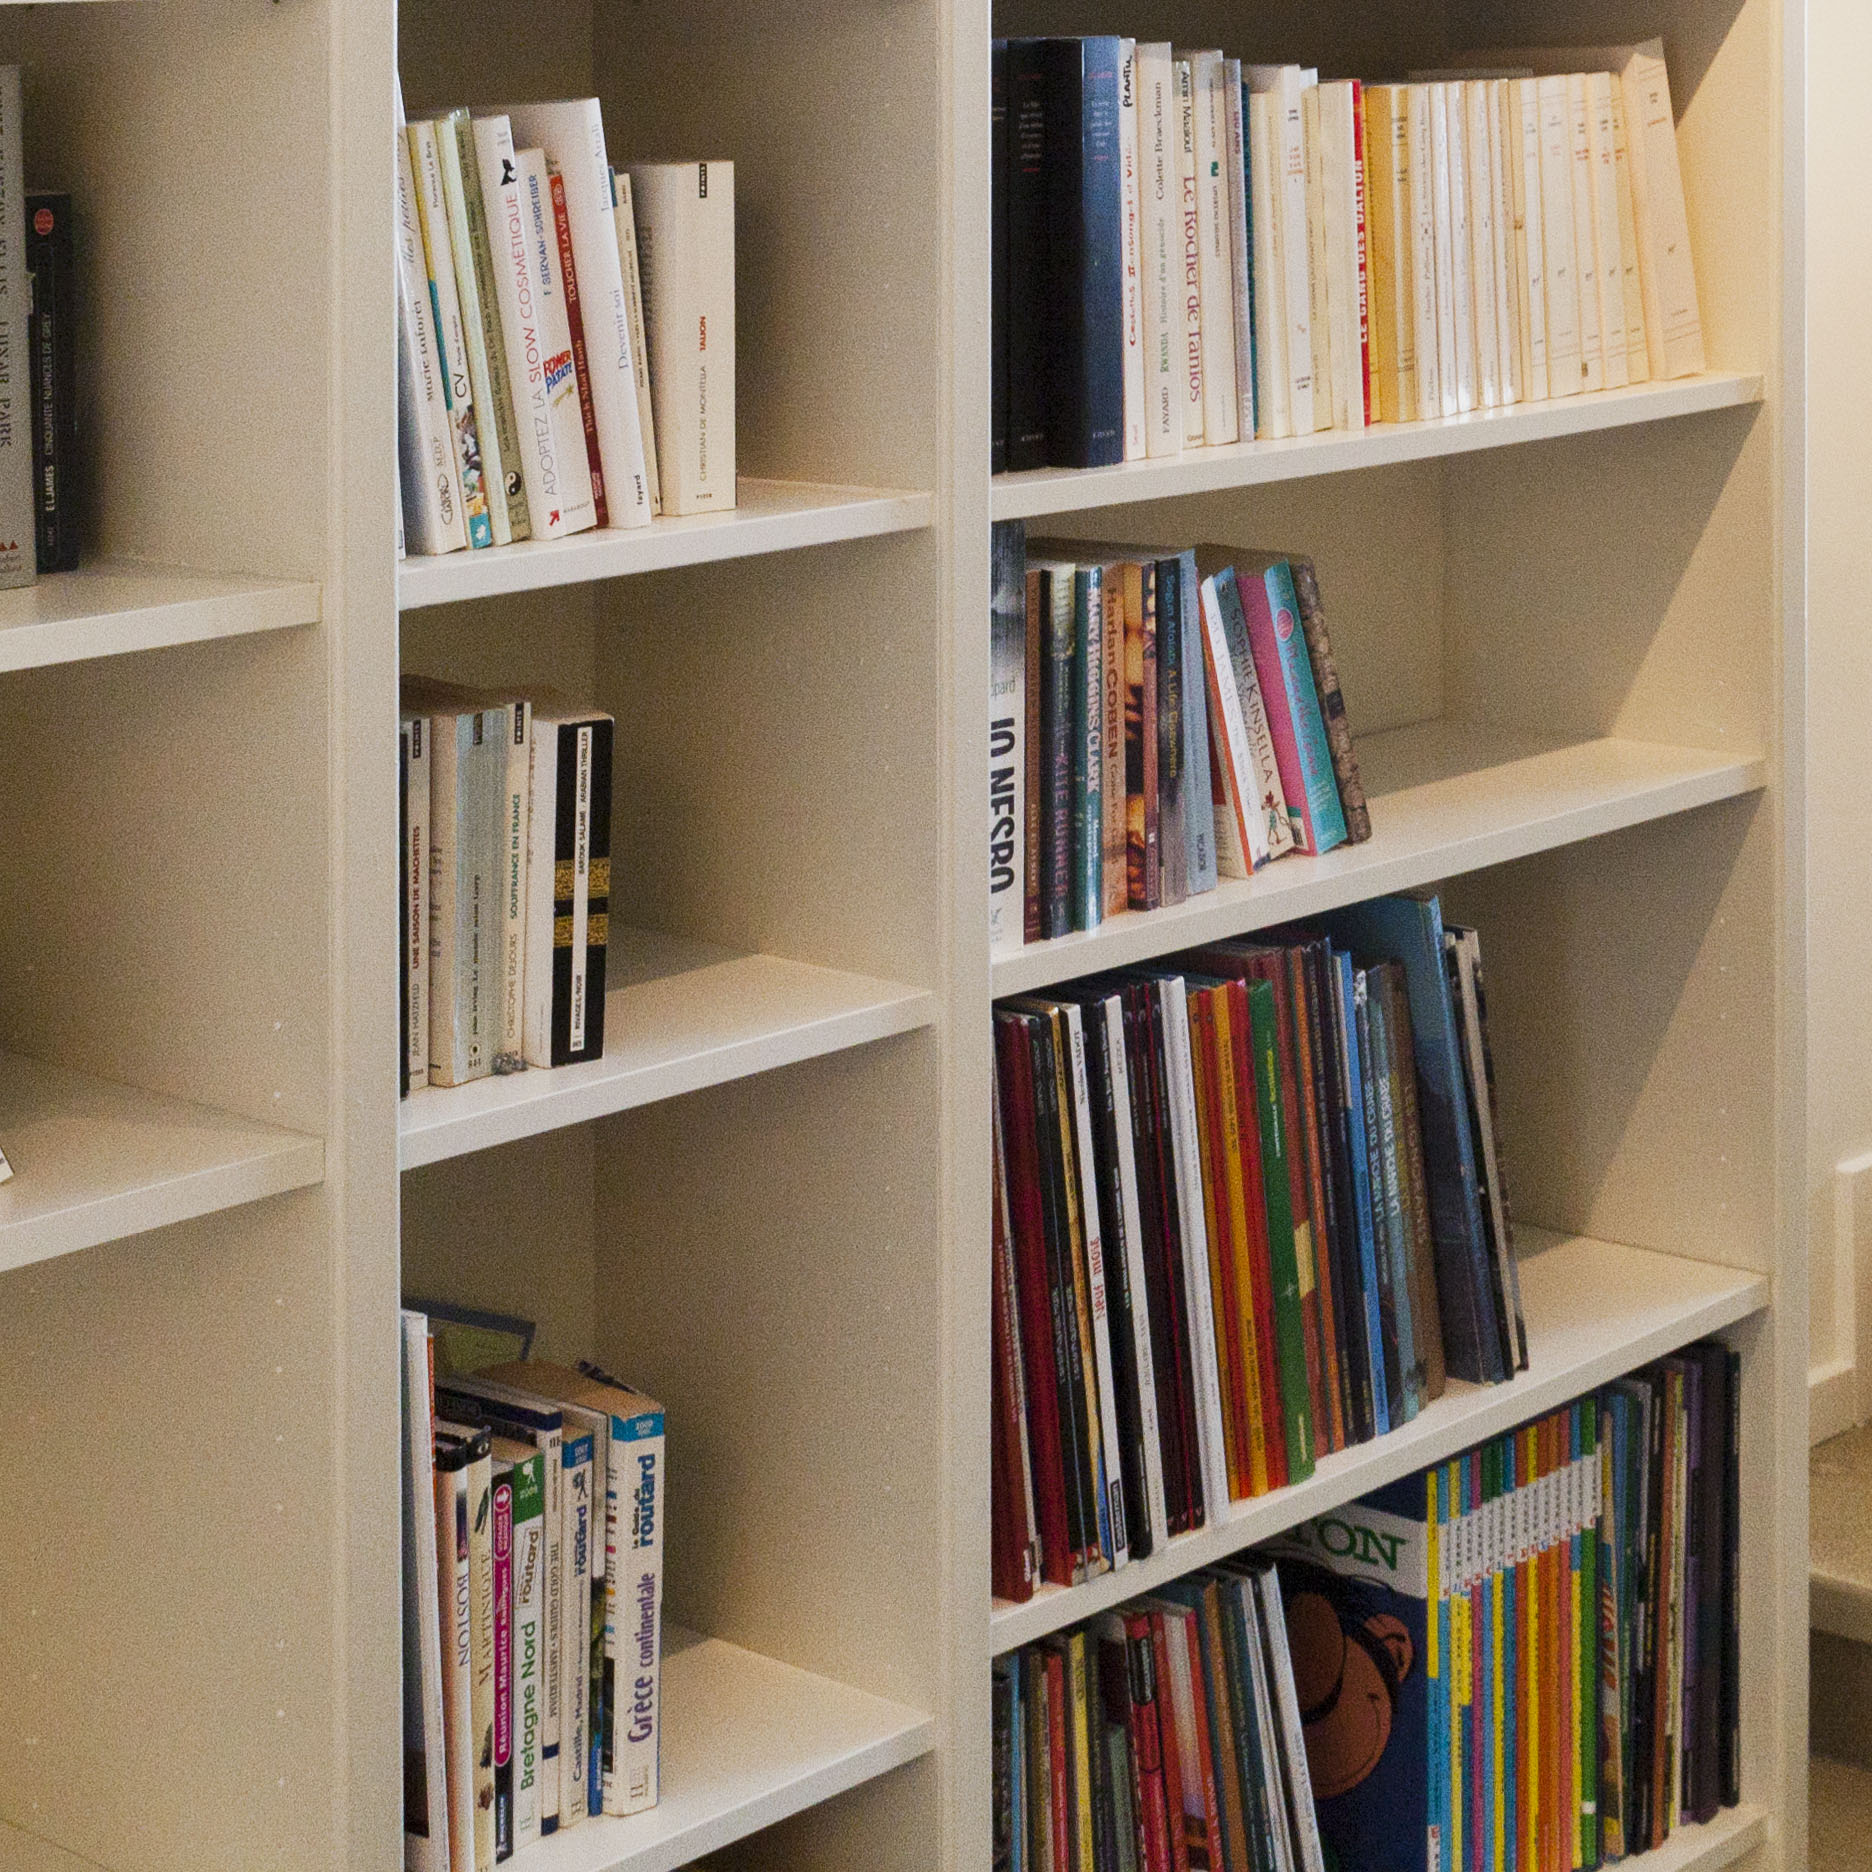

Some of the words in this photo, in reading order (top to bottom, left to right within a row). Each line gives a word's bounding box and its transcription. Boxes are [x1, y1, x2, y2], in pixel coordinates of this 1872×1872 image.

[1153, 82, 1164, 153] Braeckman
[1154, 155, 1166, 201] Colette
[1183, 176, 1197, 200] Le
[1184, 210, 1200, 290] Rocher
[1185, 294, 1200, 322] de
[523, 327, 543, 383] SLOW
[1186, 331, 1201, 402] Tanios
[532, 389, 545, 409] LA
[535, 414, 558, 496] ADOPTEZ
[511, 793, 521, 833] FRANCE
[511, 836, 520, 850] EN
[509, 853, 520, 920] SOUFFRANCE
[638, 1453, 655, 1547] routard
[520, 1620, 536, 1680] Nord
[635, 1573, 655, 1668] continentale
[520, 1683, 537, 1791] Bretagne
[627, 1676, 654, 1743] Grèce
